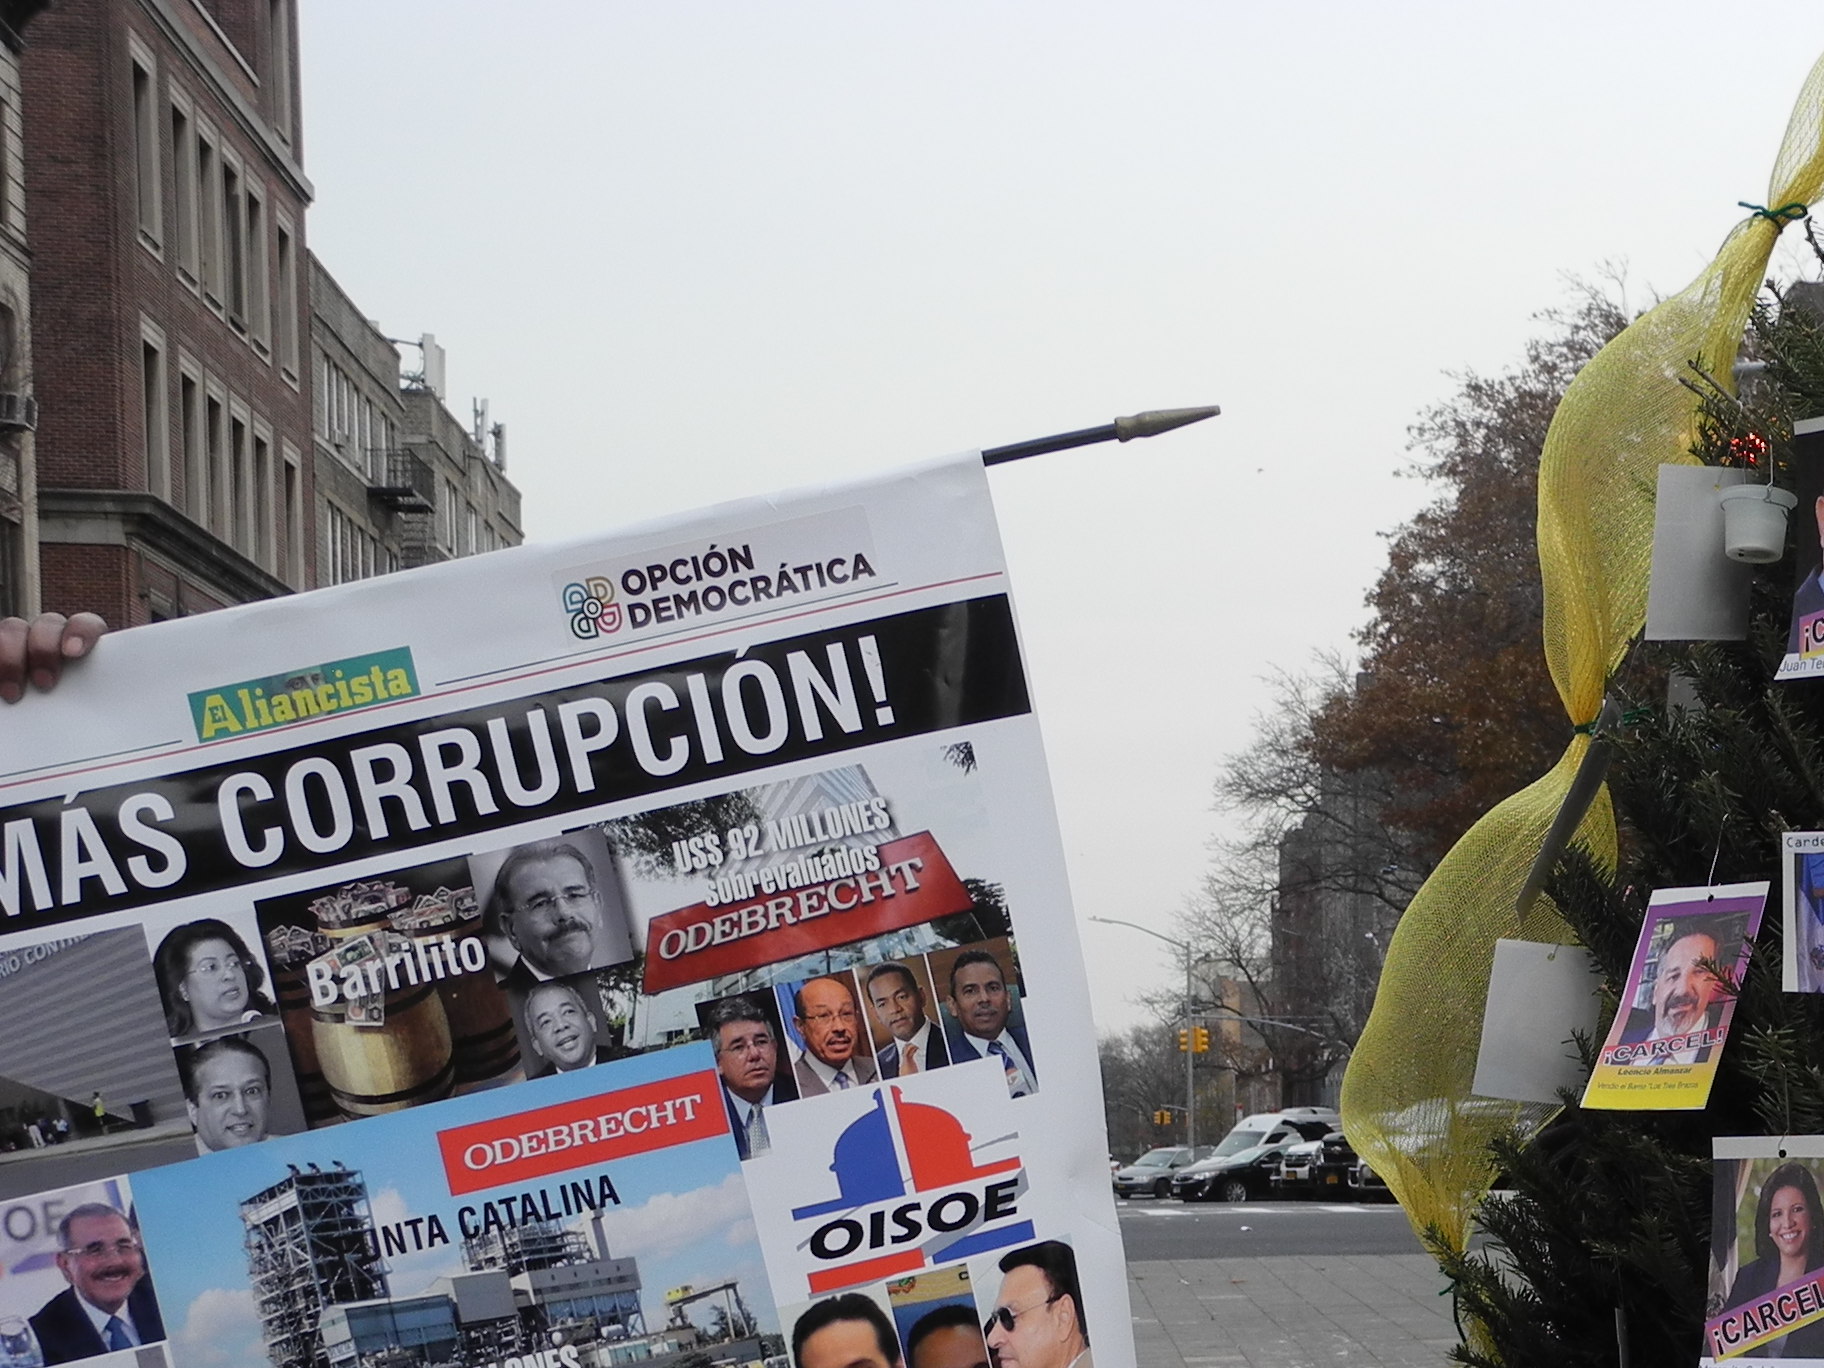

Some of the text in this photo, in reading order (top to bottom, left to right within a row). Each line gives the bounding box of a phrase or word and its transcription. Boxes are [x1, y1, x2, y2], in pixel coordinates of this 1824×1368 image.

[621, 544, 754, 596] OPCIÓN
[629, 553, 876, 631] DEMOCRÁTICA
[201, 665, 411, 739] Aliancista
[1778, 657, 1808, 674] Juan
[218, 635, 896, 870] CORRUPCIÓN!
[672, 797, 890, 875] US$ 92 MILLONES
[658, 857, 924, 961] ODEBRECHT
[704, 844, 881, 908] sobrevaluados
[306, 936, 487, 1007] Barrilito
[1604, 1029, 1724, 1065] ¡CARCEL!
[463, 1094, 702, 1171] ODEBRECHT
[457, 1174, 622, 1241] CATALINA
[809, 1178, 1020, 1260] OISOE
